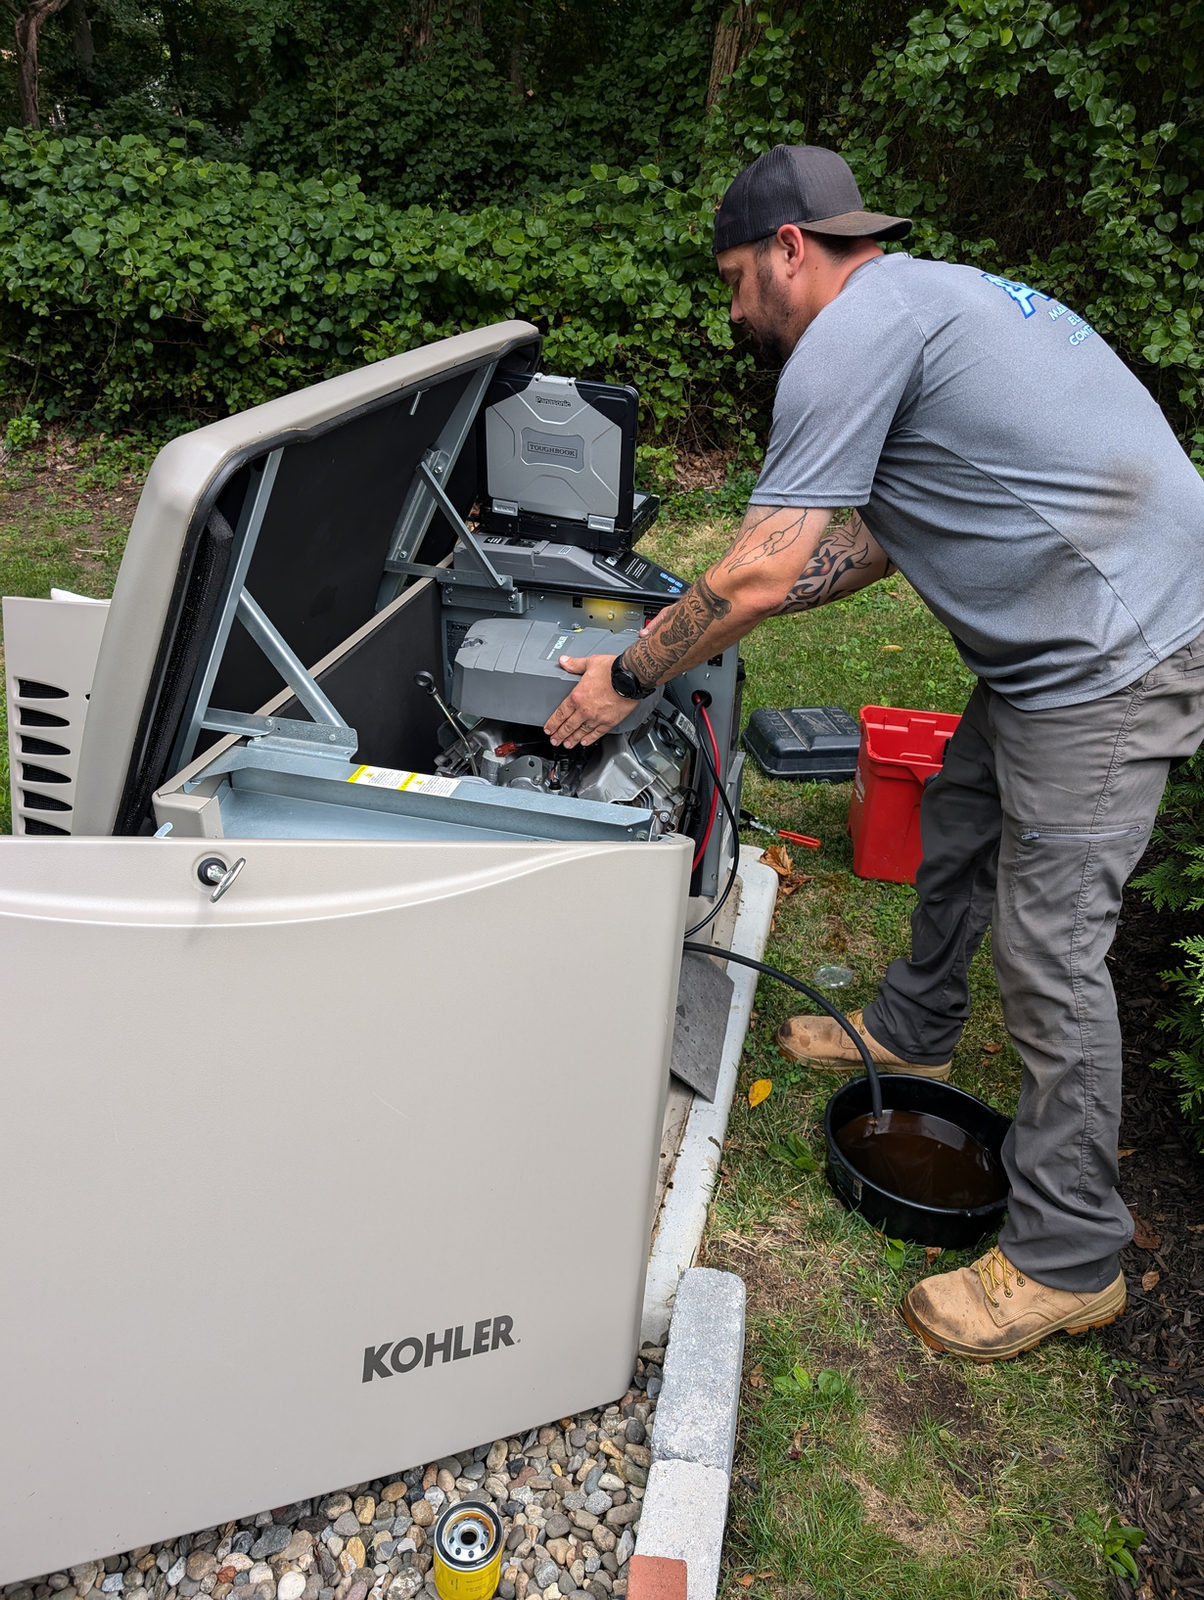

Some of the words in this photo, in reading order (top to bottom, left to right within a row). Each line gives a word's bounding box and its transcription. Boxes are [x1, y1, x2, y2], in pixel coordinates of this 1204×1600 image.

[535, 395, 572, 407] Panasonic
[529, 444, 576, 456] TOUGHBOOK
[362, 1314, 515, 1384] KOHLER
